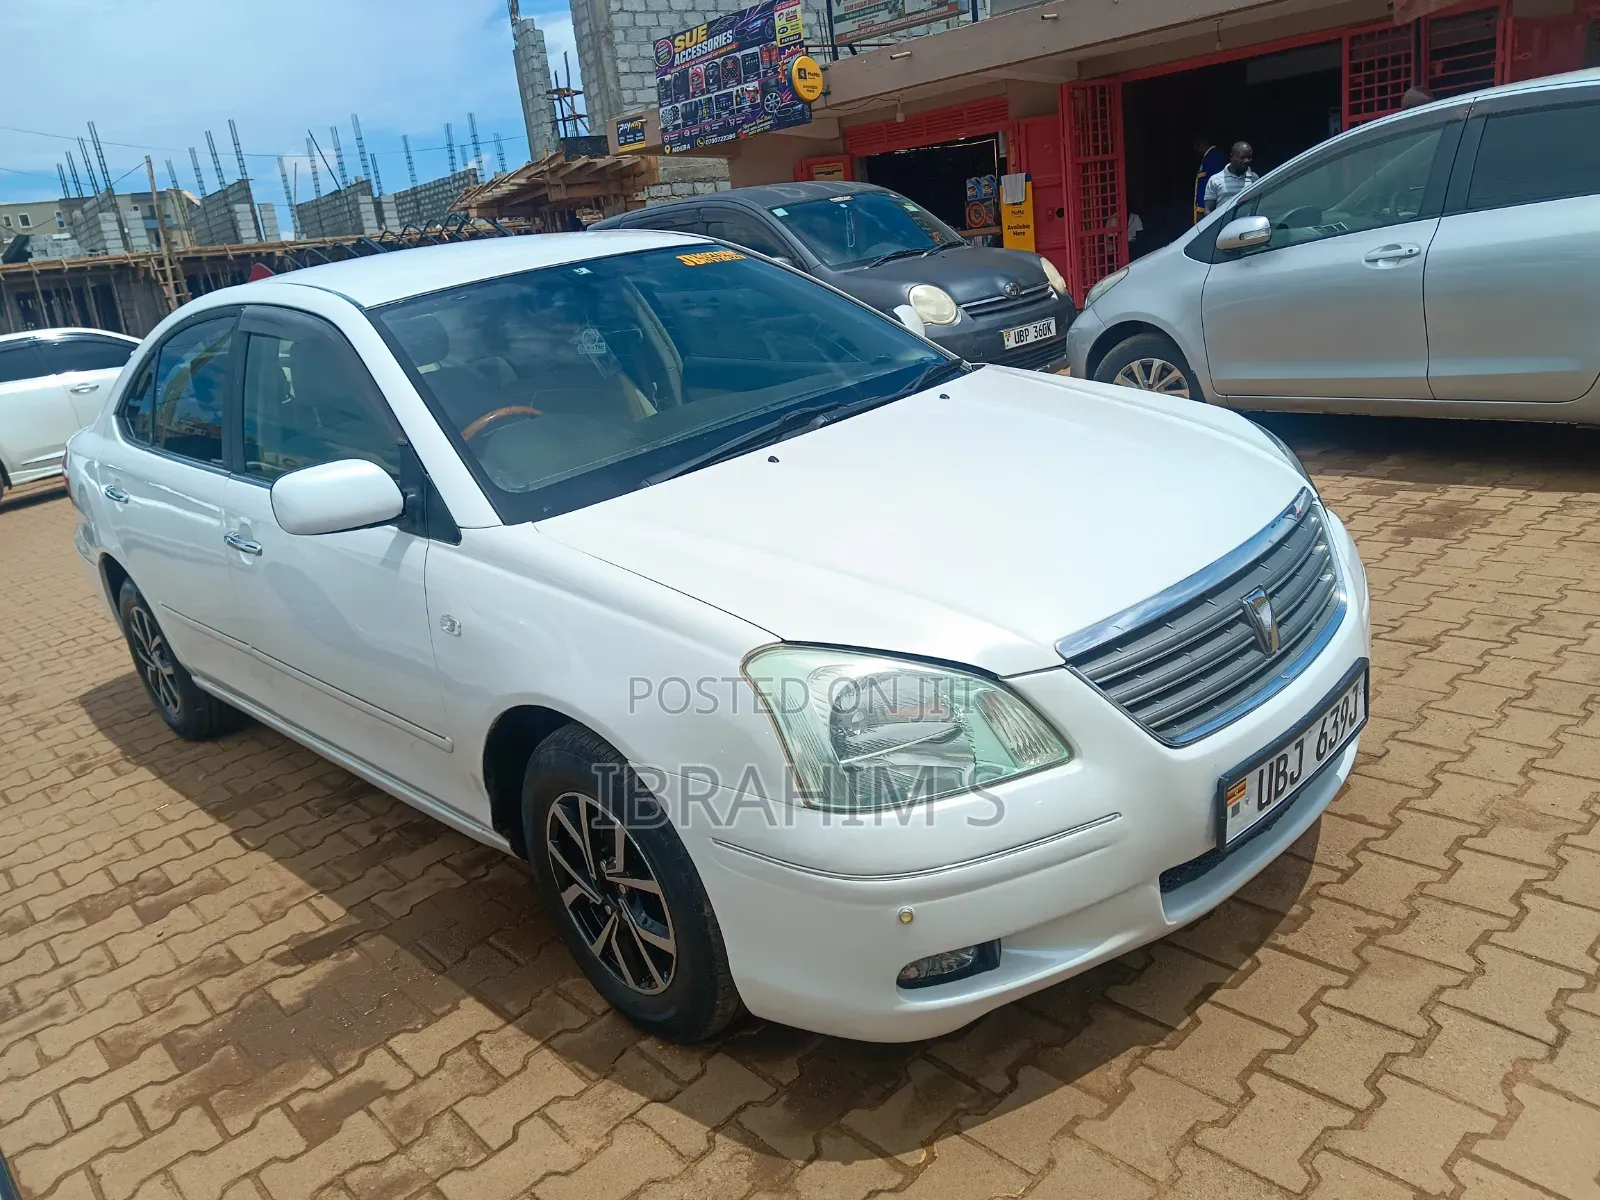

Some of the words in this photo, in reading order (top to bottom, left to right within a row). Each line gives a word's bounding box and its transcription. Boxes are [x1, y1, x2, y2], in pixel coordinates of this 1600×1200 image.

[674, 23, 708, 53] SUE
[674, 30, 733, 67] ACCESSORIES
[1013, 328, 1030, 344] UBP
[1257, 737, 1305, 812] UBJ
[1315, 682, 1360, 762] 639J
